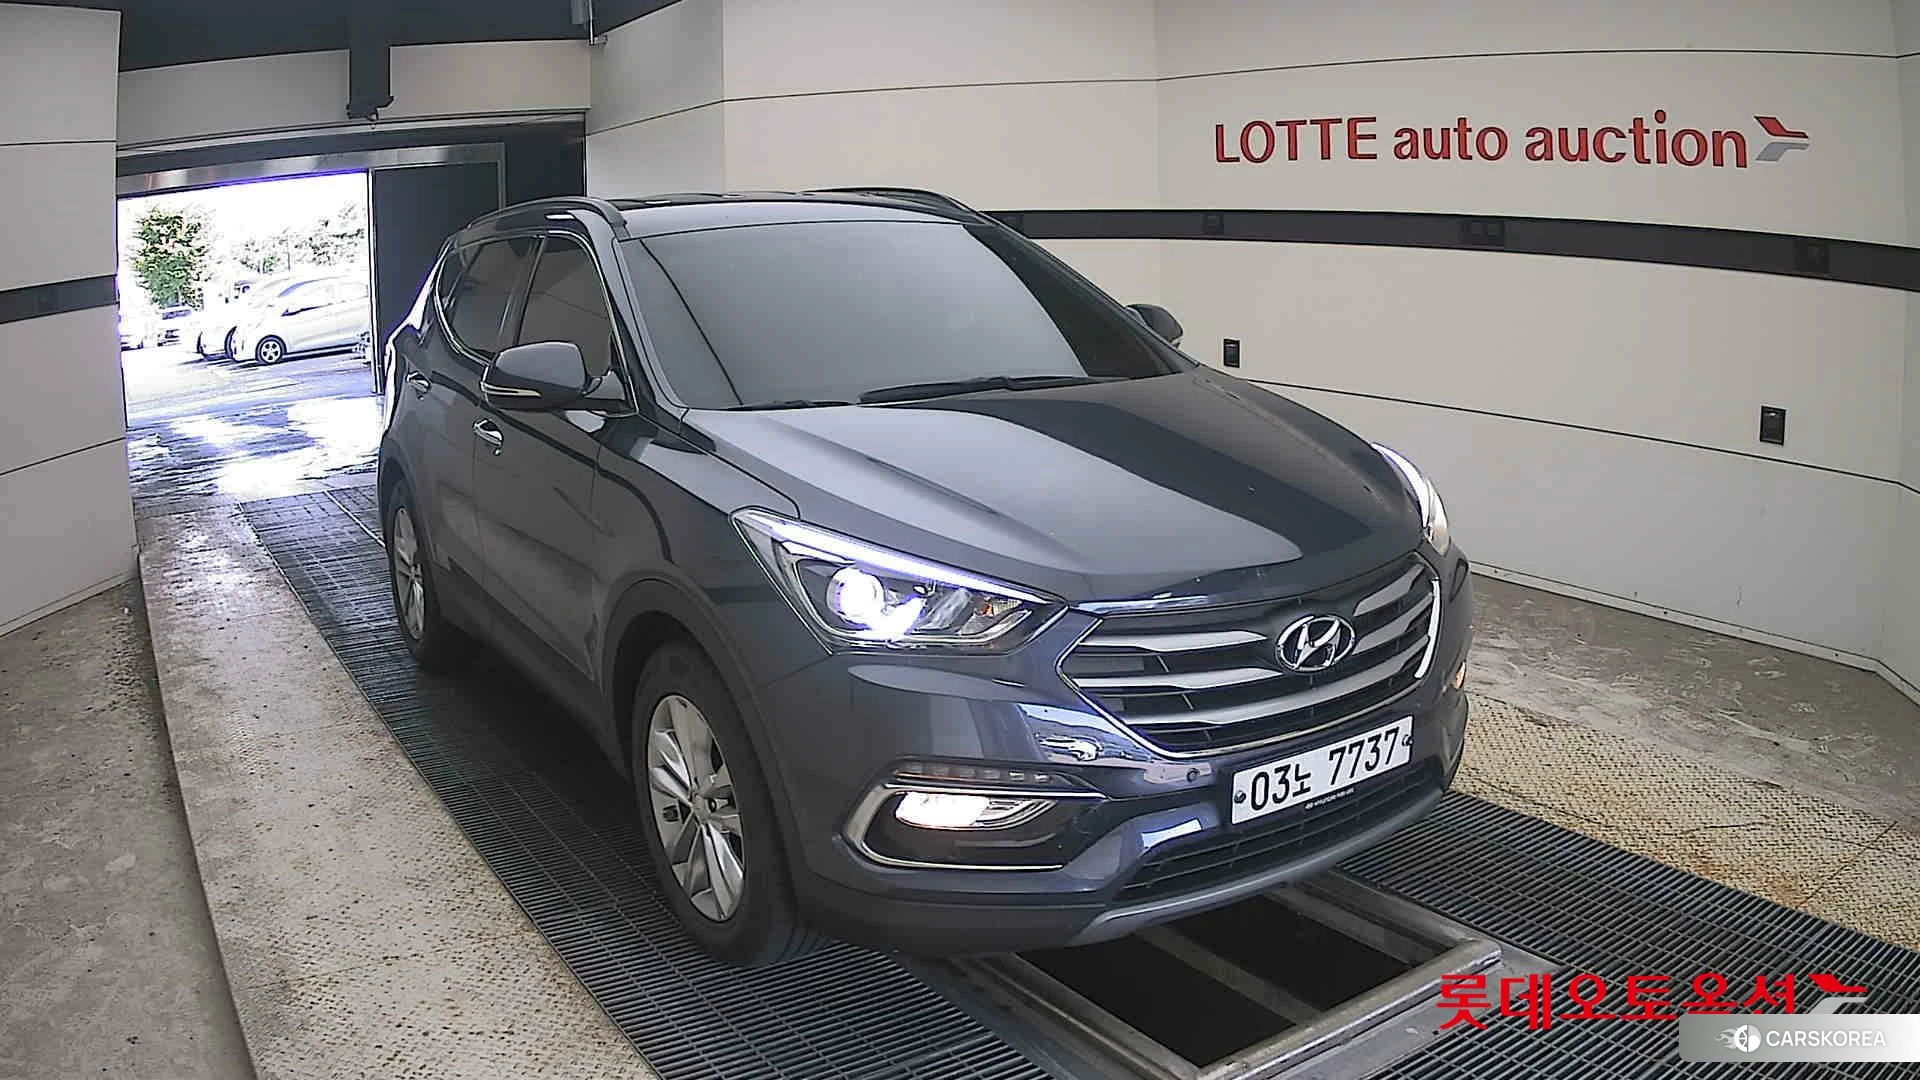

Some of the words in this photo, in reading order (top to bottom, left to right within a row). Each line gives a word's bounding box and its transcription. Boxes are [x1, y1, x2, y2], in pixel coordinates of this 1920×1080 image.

[1215, 116, 1377, 164] LOTTE
[1392, 116, 1508, 162] auto
[1524, 110, 1748, 168] auction
[1250, 763, 1311, 811] 03노
[1328, 726, 1400, 786] 7737
